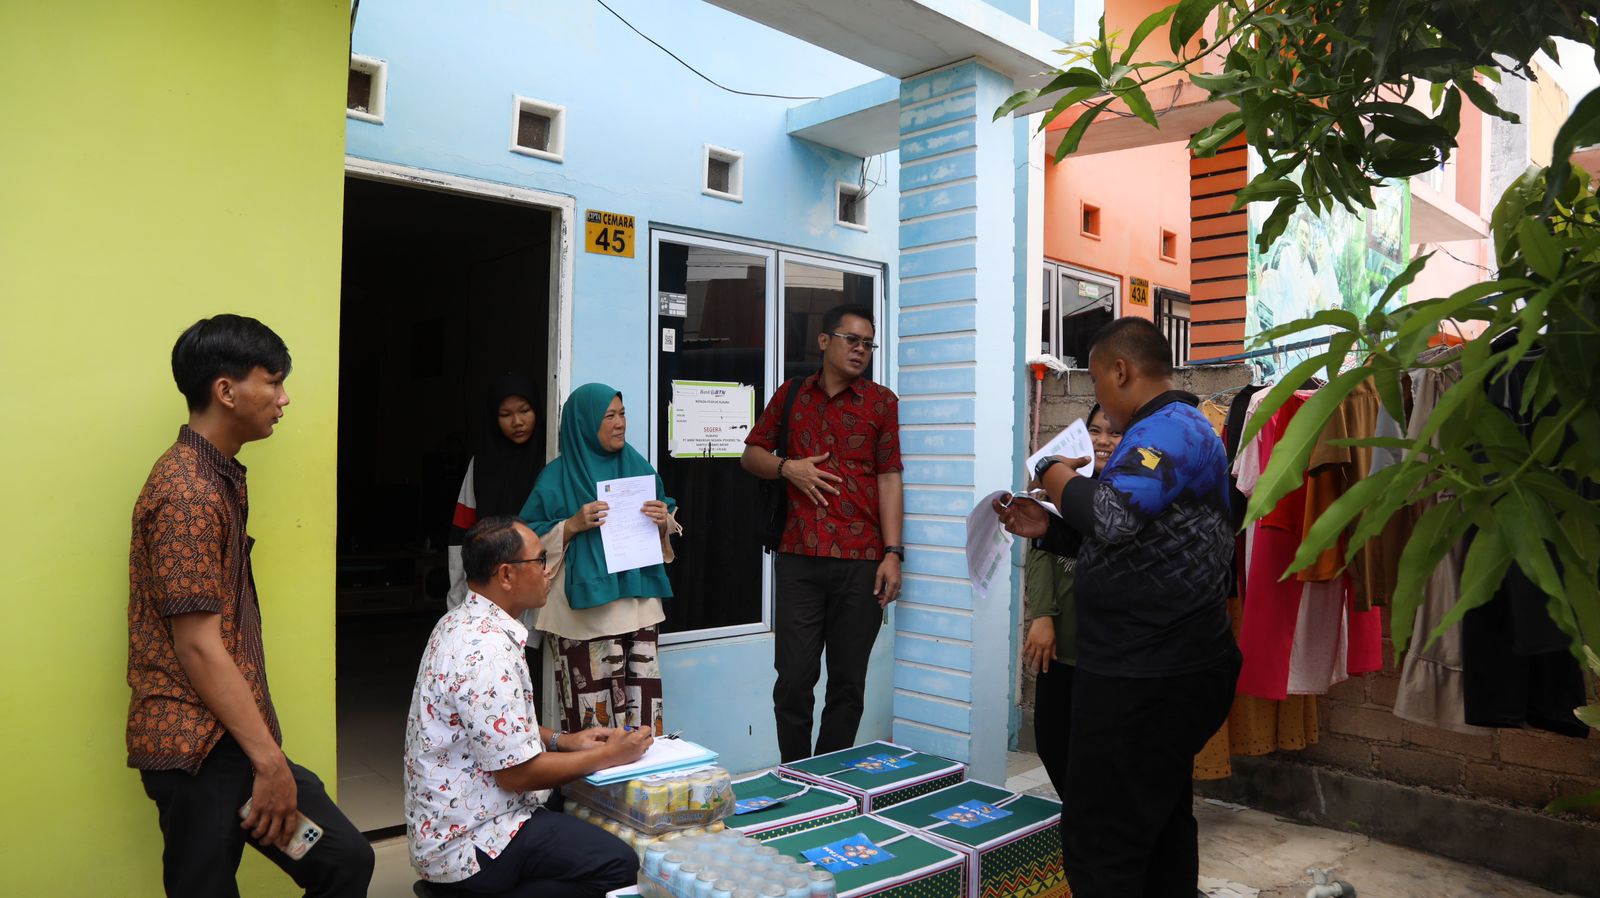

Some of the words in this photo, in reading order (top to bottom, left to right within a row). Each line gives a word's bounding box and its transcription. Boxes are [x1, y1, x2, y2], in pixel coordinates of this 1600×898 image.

[602, 213, 634, 229] CEMARA
[595, 227, 626, 253] 45
[1131, 286, 1147, 304] 43A
